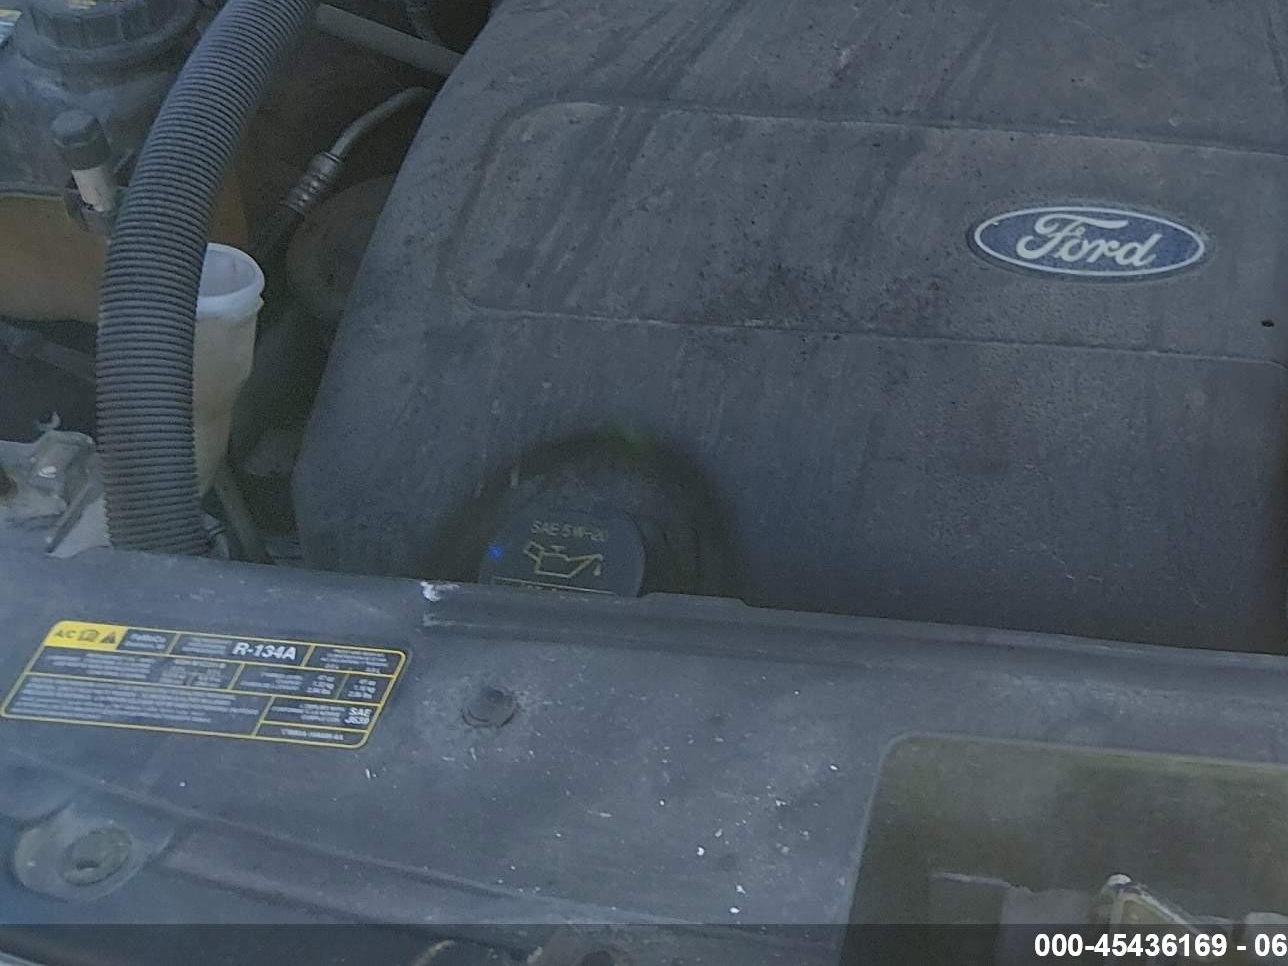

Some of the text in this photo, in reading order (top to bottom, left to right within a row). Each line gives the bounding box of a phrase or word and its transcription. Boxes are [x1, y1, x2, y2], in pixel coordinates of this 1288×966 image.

[1015, 213, 1164, 268] Ford
[231, 641, 297, 660] R-134A
[348, 707, 373, 717] SAE
